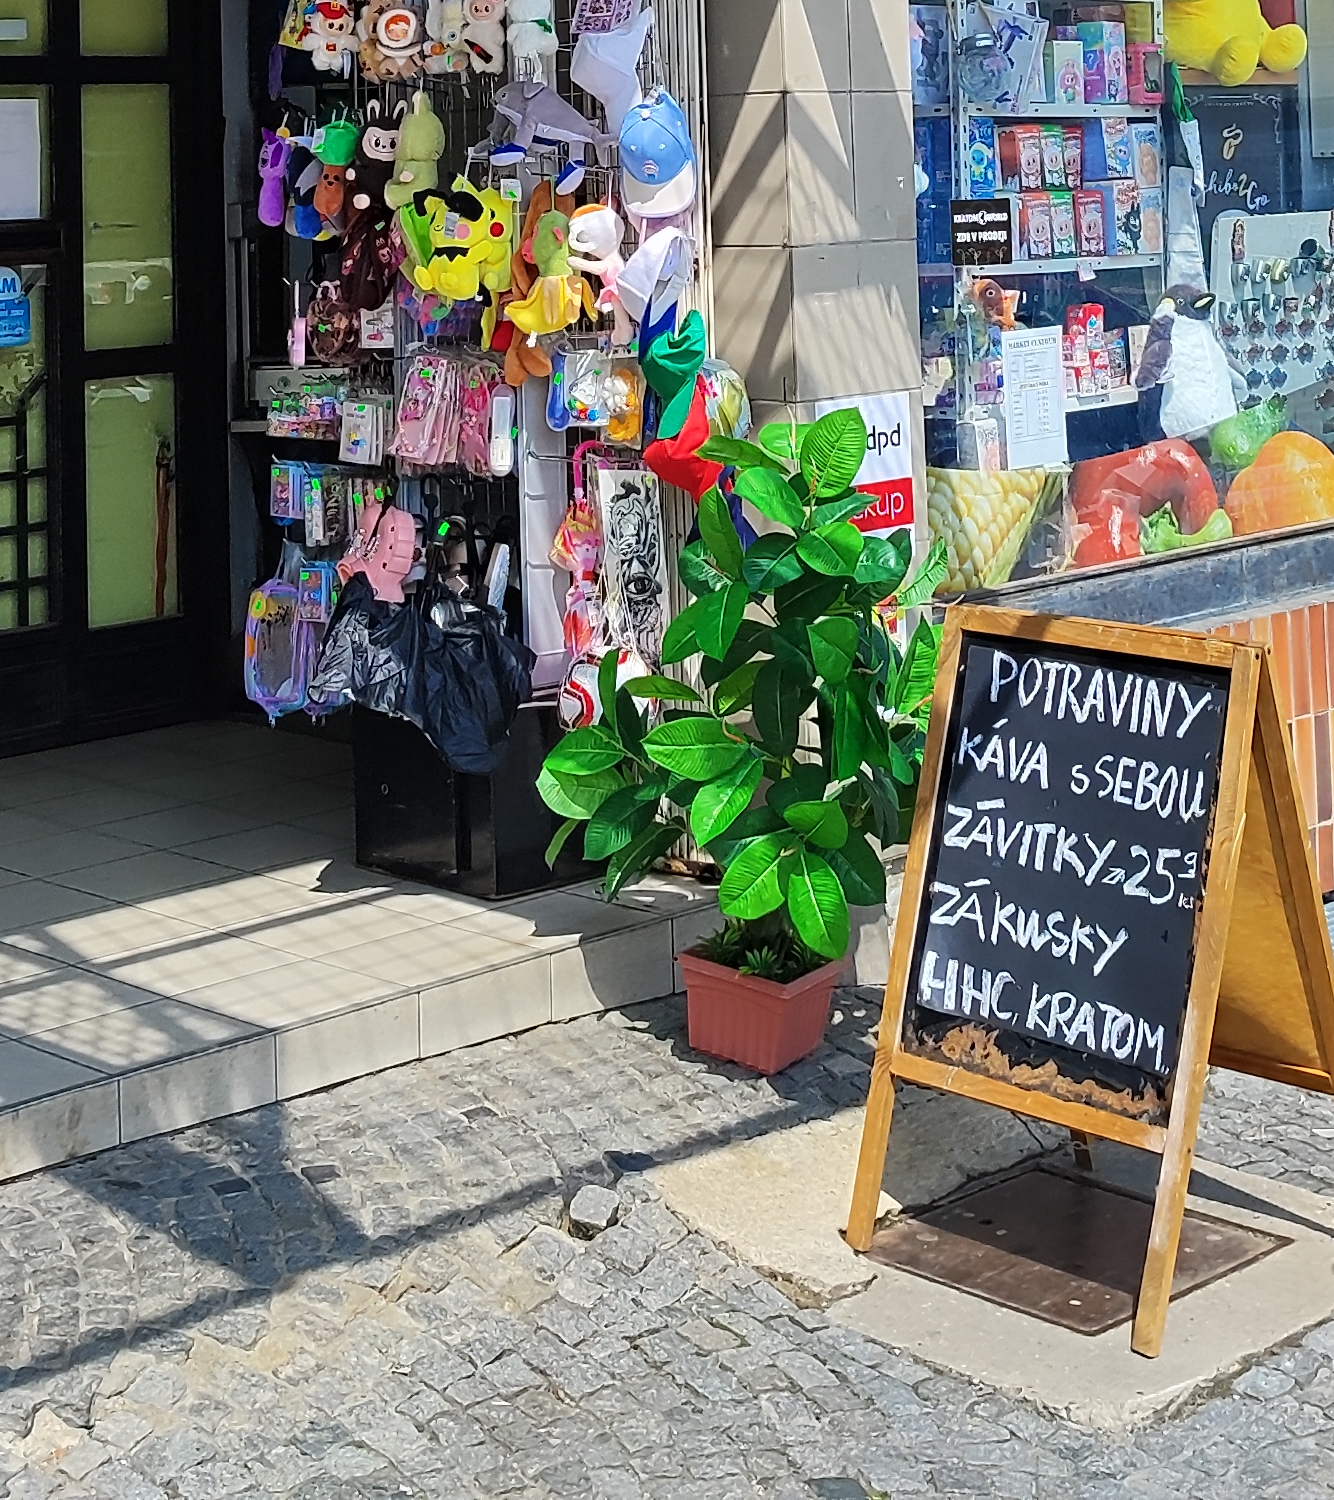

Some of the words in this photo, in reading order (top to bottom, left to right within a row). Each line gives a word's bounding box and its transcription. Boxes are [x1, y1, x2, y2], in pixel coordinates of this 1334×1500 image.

[867, 422, 901, 456] dpd
[990, 650, 1212, 739] POTRAVINY
[957, 718, 1049, 790] KÁVA
[1094, 754, 1207, 823] SEBOU
